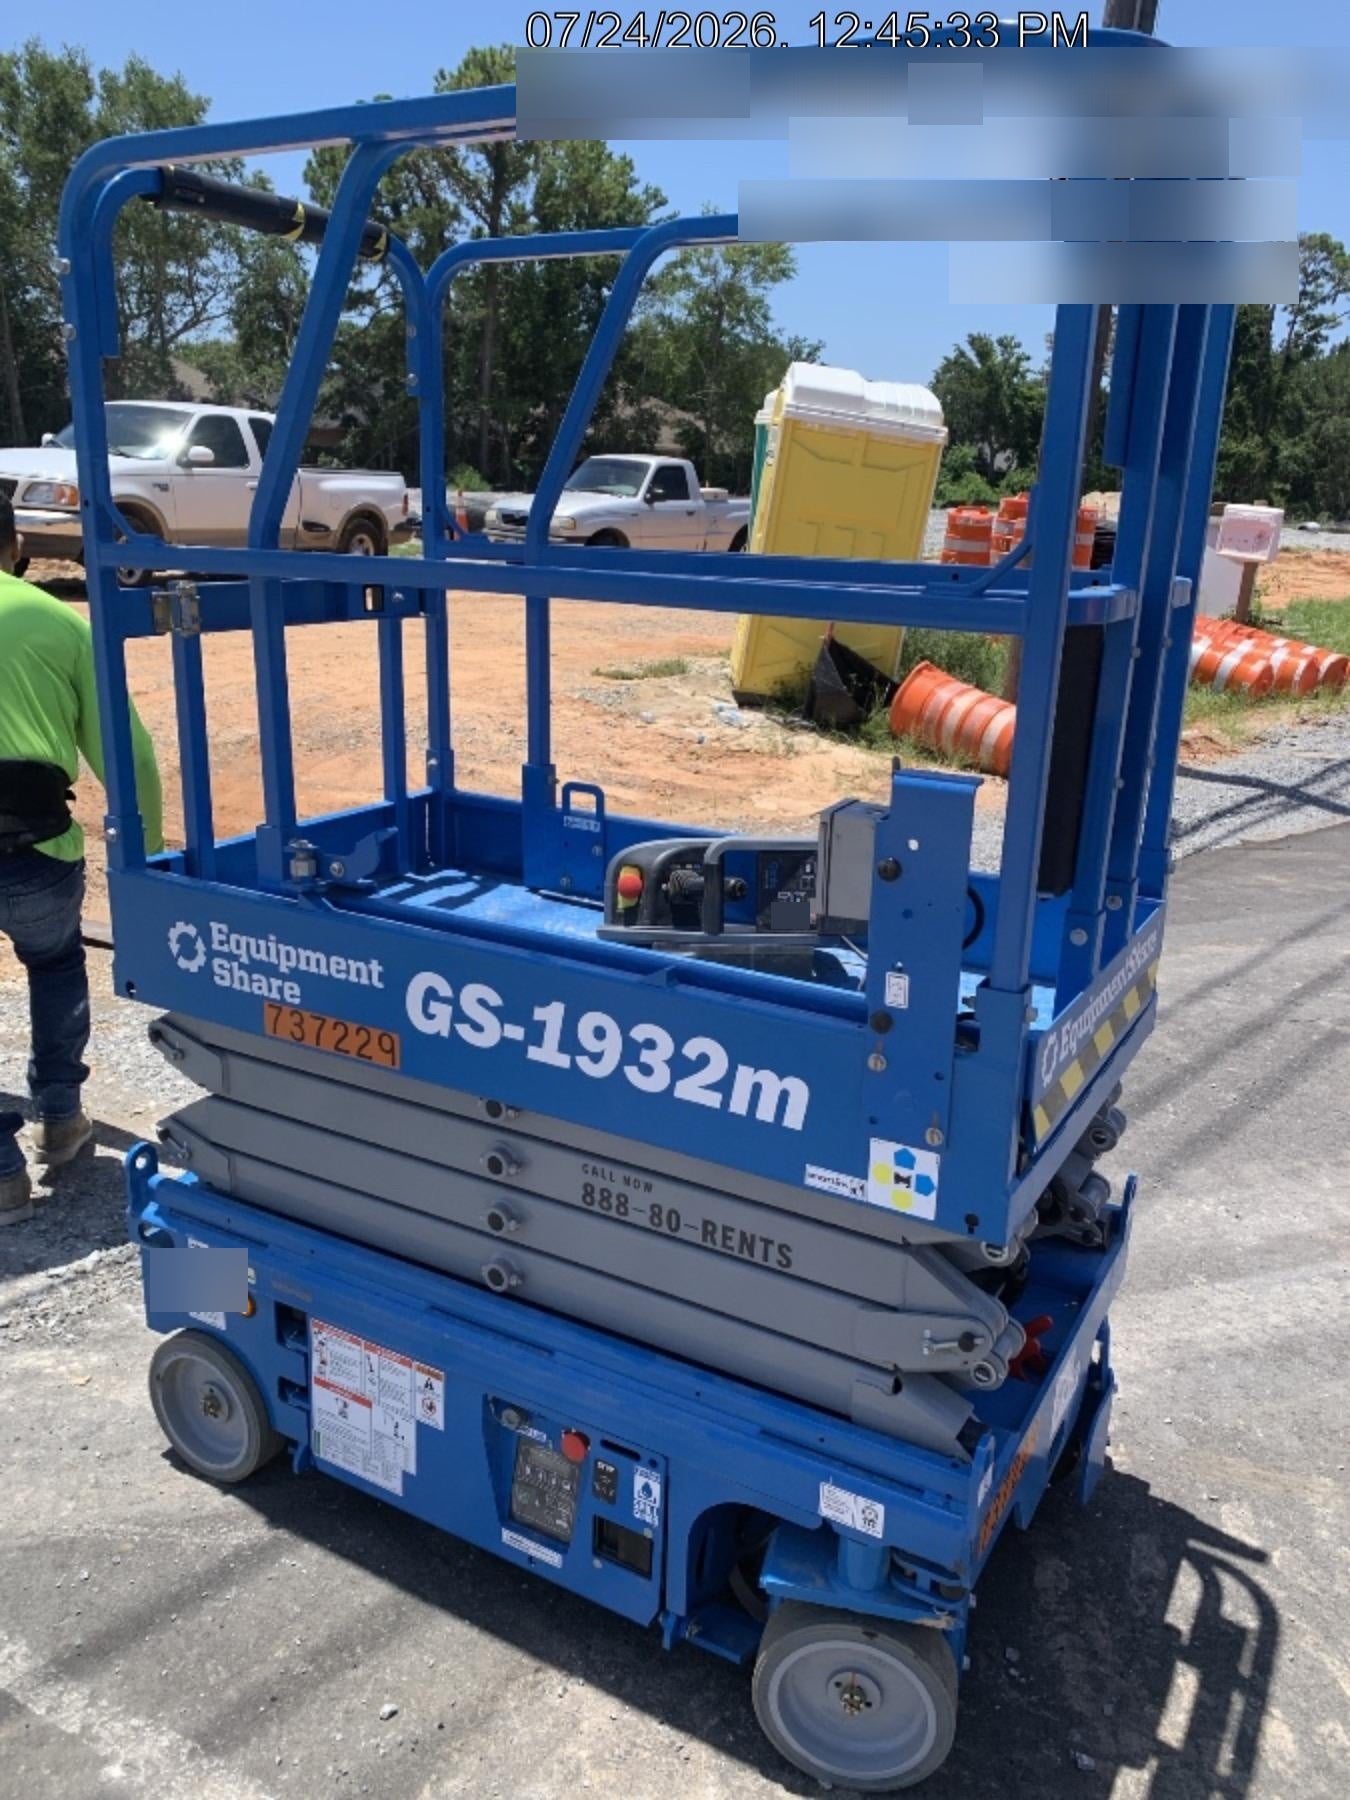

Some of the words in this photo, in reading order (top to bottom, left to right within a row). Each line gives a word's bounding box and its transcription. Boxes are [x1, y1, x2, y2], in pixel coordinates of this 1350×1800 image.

[209, 921, 385, 989] Equipment
[211, 957, 301, 1005] Share
[266, 1002, 397, 1067] 737229
[404, 971, 811, 1131] GS-1932m
[582, 1163, 616, 1184] CALL
[623, 1174, 654, 1194] NOW
[581, 1182, 794, 1270] 888-80-RENTS
